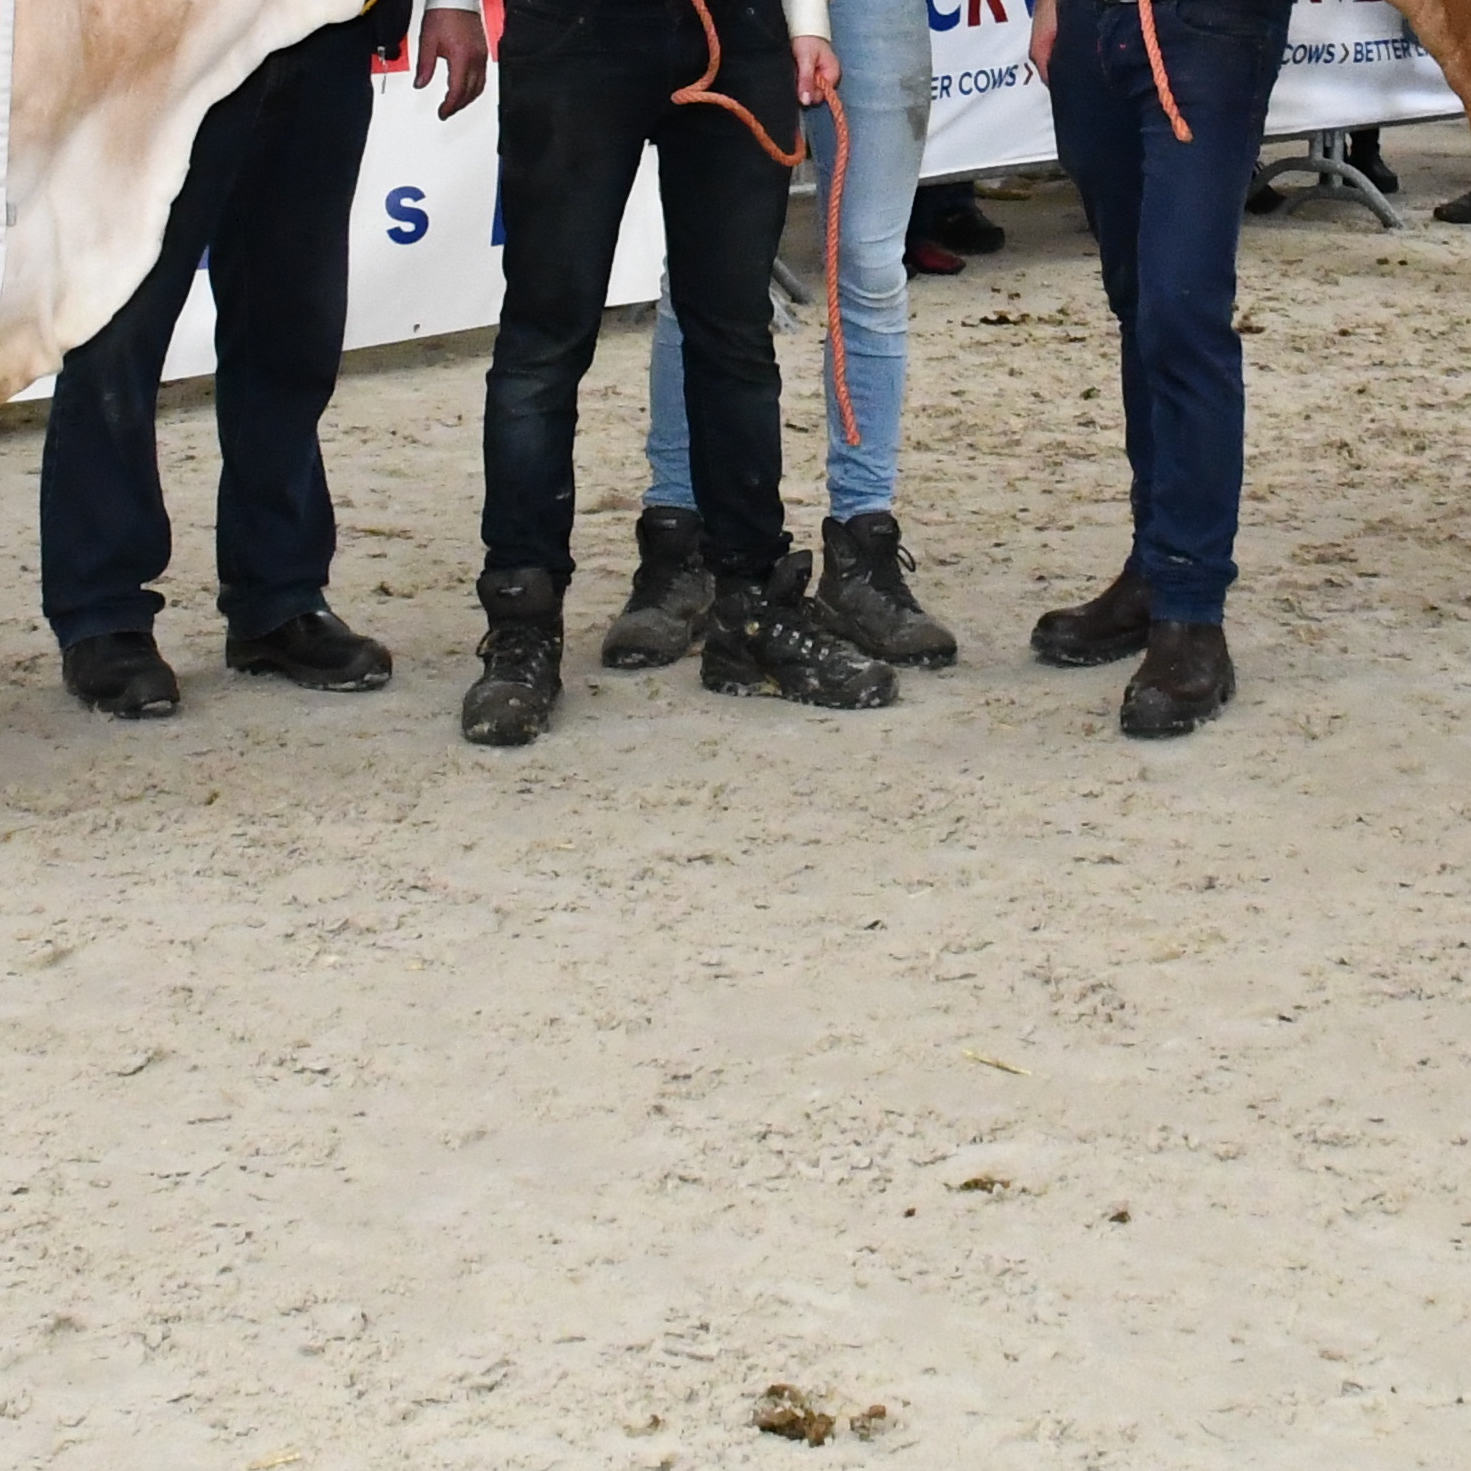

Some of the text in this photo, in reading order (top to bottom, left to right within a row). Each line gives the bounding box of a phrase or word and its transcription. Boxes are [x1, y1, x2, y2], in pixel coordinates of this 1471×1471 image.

[1281, 38, 1412, 65] COWS BETTER
[959, 64, 1019, 95] COWS
